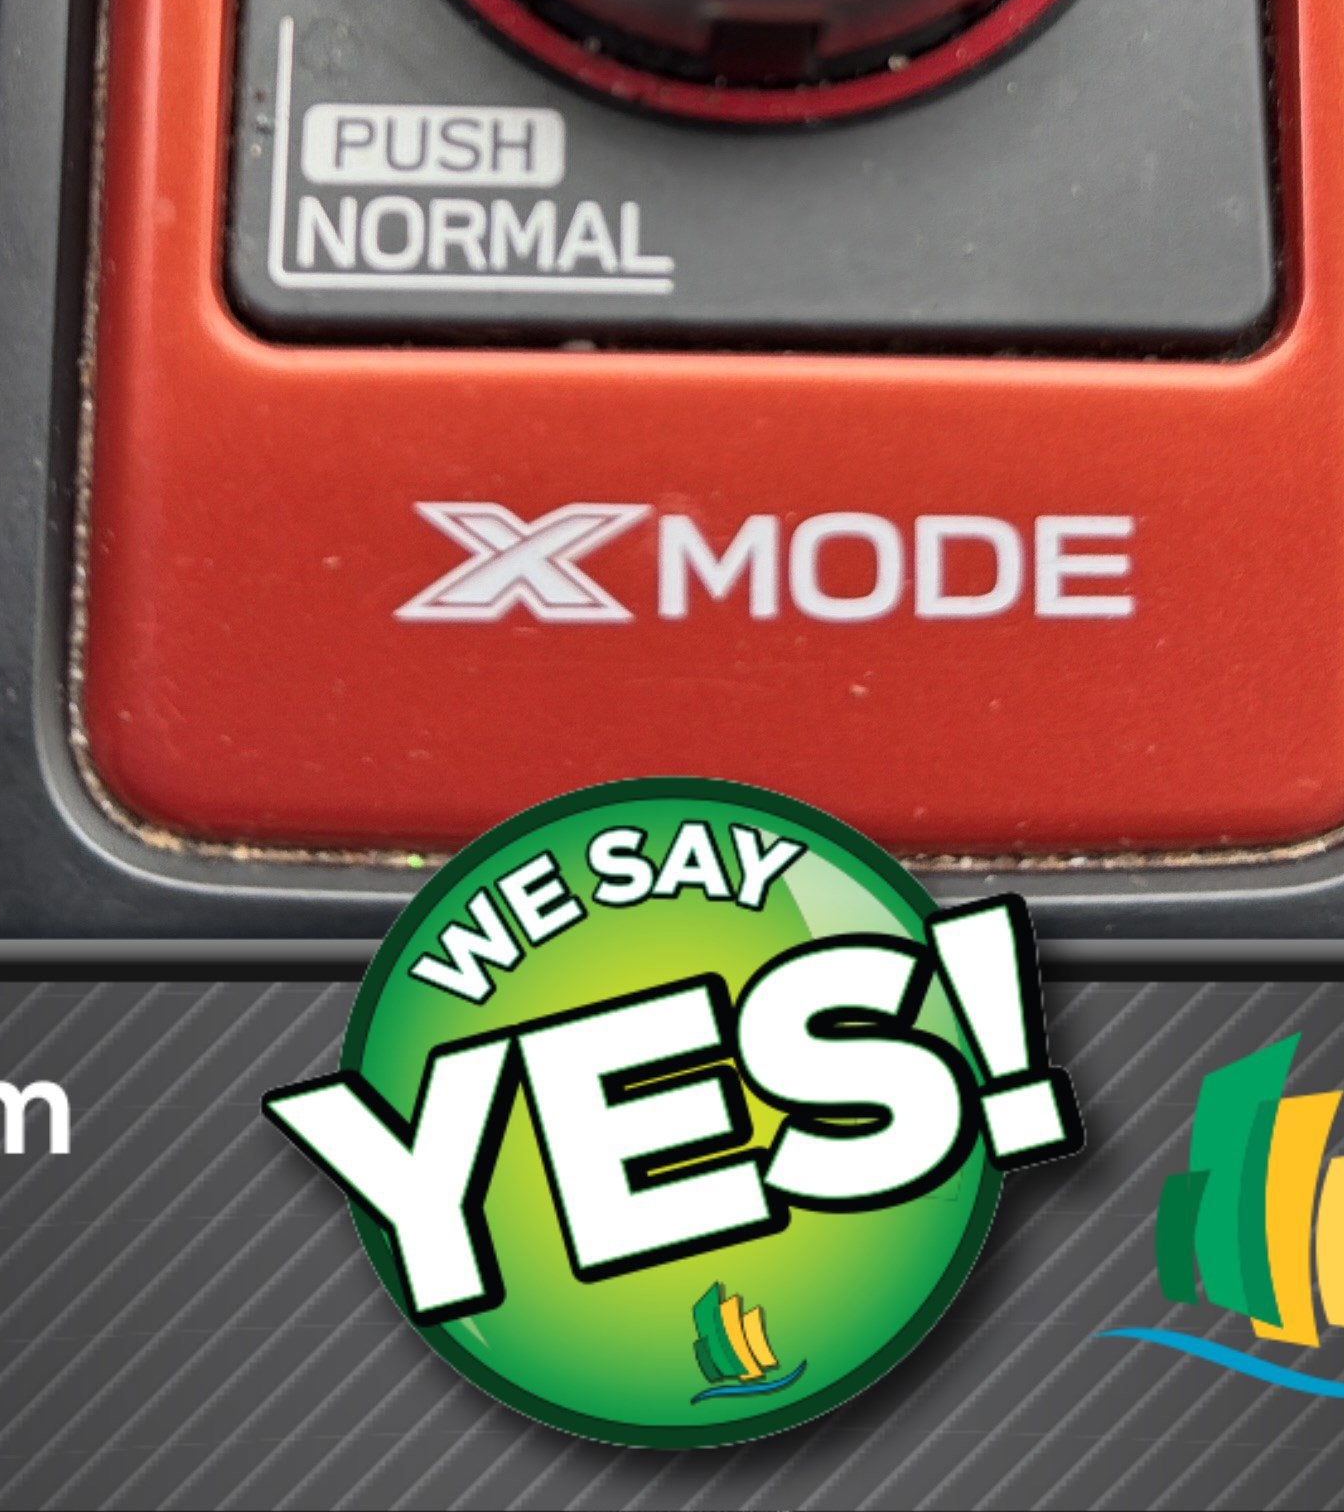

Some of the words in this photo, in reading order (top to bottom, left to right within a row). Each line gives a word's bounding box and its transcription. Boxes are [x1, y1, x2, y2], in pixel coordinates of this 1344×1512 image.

[332, 116, 537, 173] PUSH
[296, 195, 675, 273] NORMAL
[657, 511, 1137, 621] MODE
